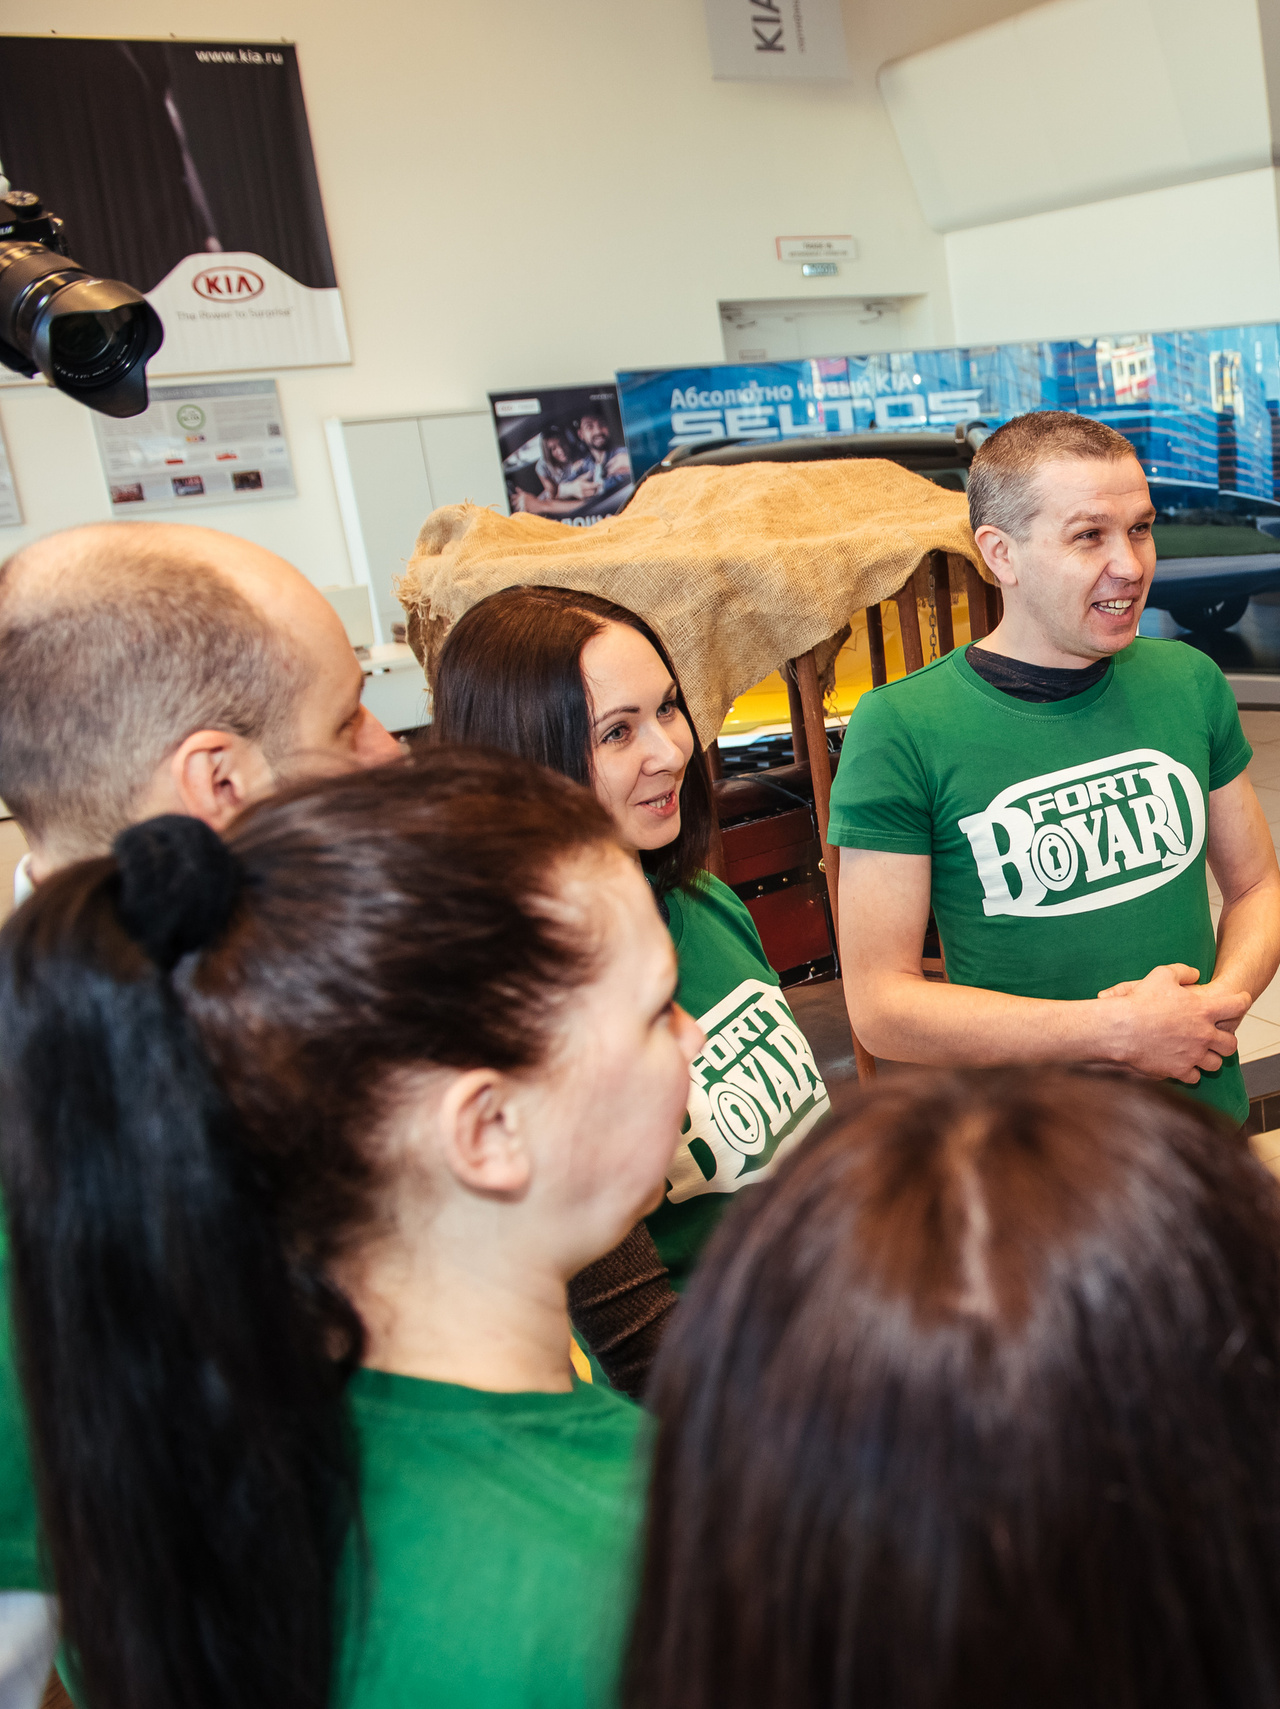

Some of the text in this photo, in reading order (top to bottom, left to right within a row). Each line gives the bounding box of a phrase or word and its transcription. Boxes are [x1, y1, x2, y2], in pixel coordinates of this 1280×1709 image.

[195, 48, 284, 65] www.kia.ru
[205, 275, 253, 294] KIA
[667, 388, 983, 447] SELTOS
[670, 383, 793, 410] Абсолютно
[876, 371, 914, 393] KIA
[1027, 769, 1138, 824] FORT
[958, 763, 1206, 917] BOYARD
[690, 1003, 768, 1087] FORT
